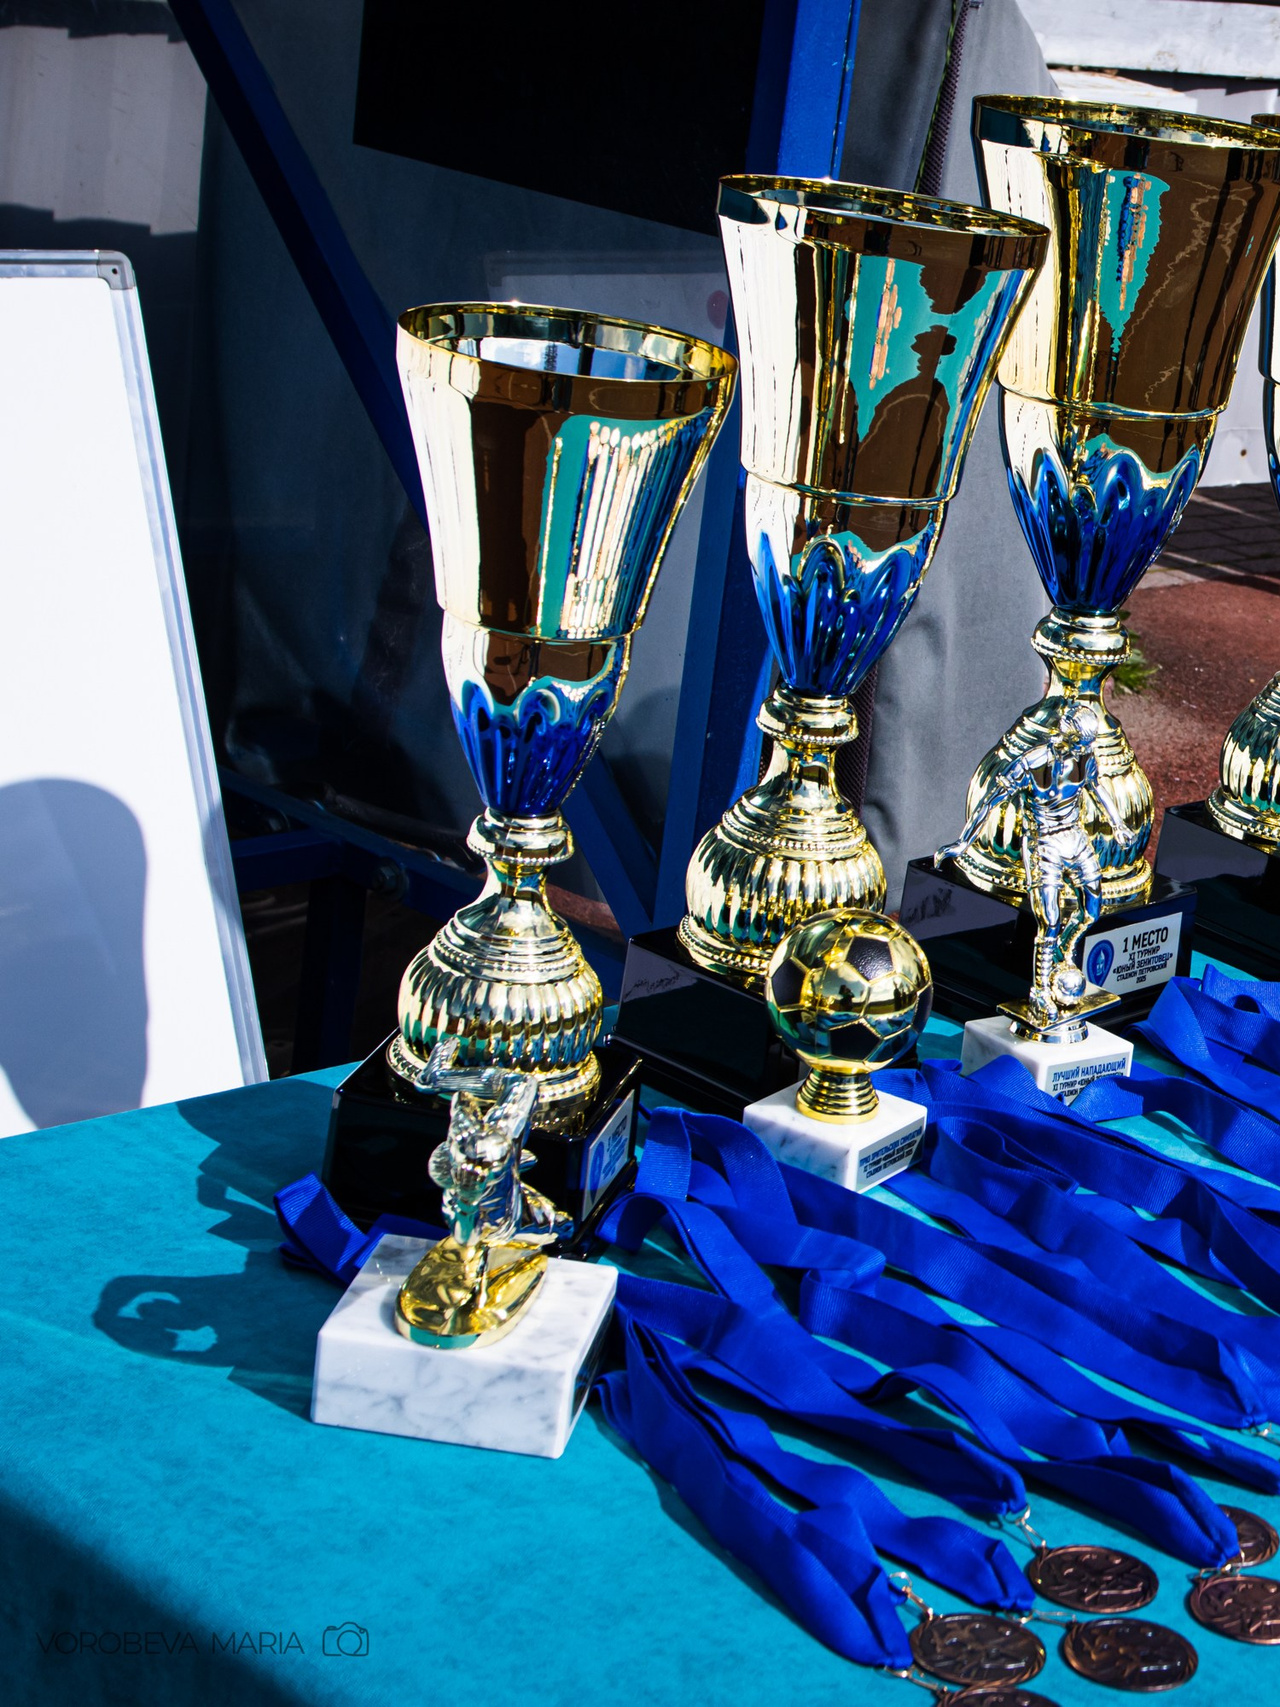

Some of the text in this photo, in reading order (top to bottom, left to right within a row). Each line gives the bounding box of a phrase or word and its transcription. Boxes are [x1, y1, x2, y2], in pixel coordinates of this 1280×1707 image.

[1122, 926, 1168, 953] 1 МЕСТО
[1136, 946, 1160, 959] ТУРНИР
[1112, 952, 1173, 974] «ЮНЫЙ ЗЕНИТОВЕЦ»
[1116, 970, 1138, 982] СТАДИОН
[1052, 1058, 1126, 1082] ЛУЧШИЙ НАПАДАЮЩИЙ
[1060, 1080, 1078, 1090] ТУРНИР
